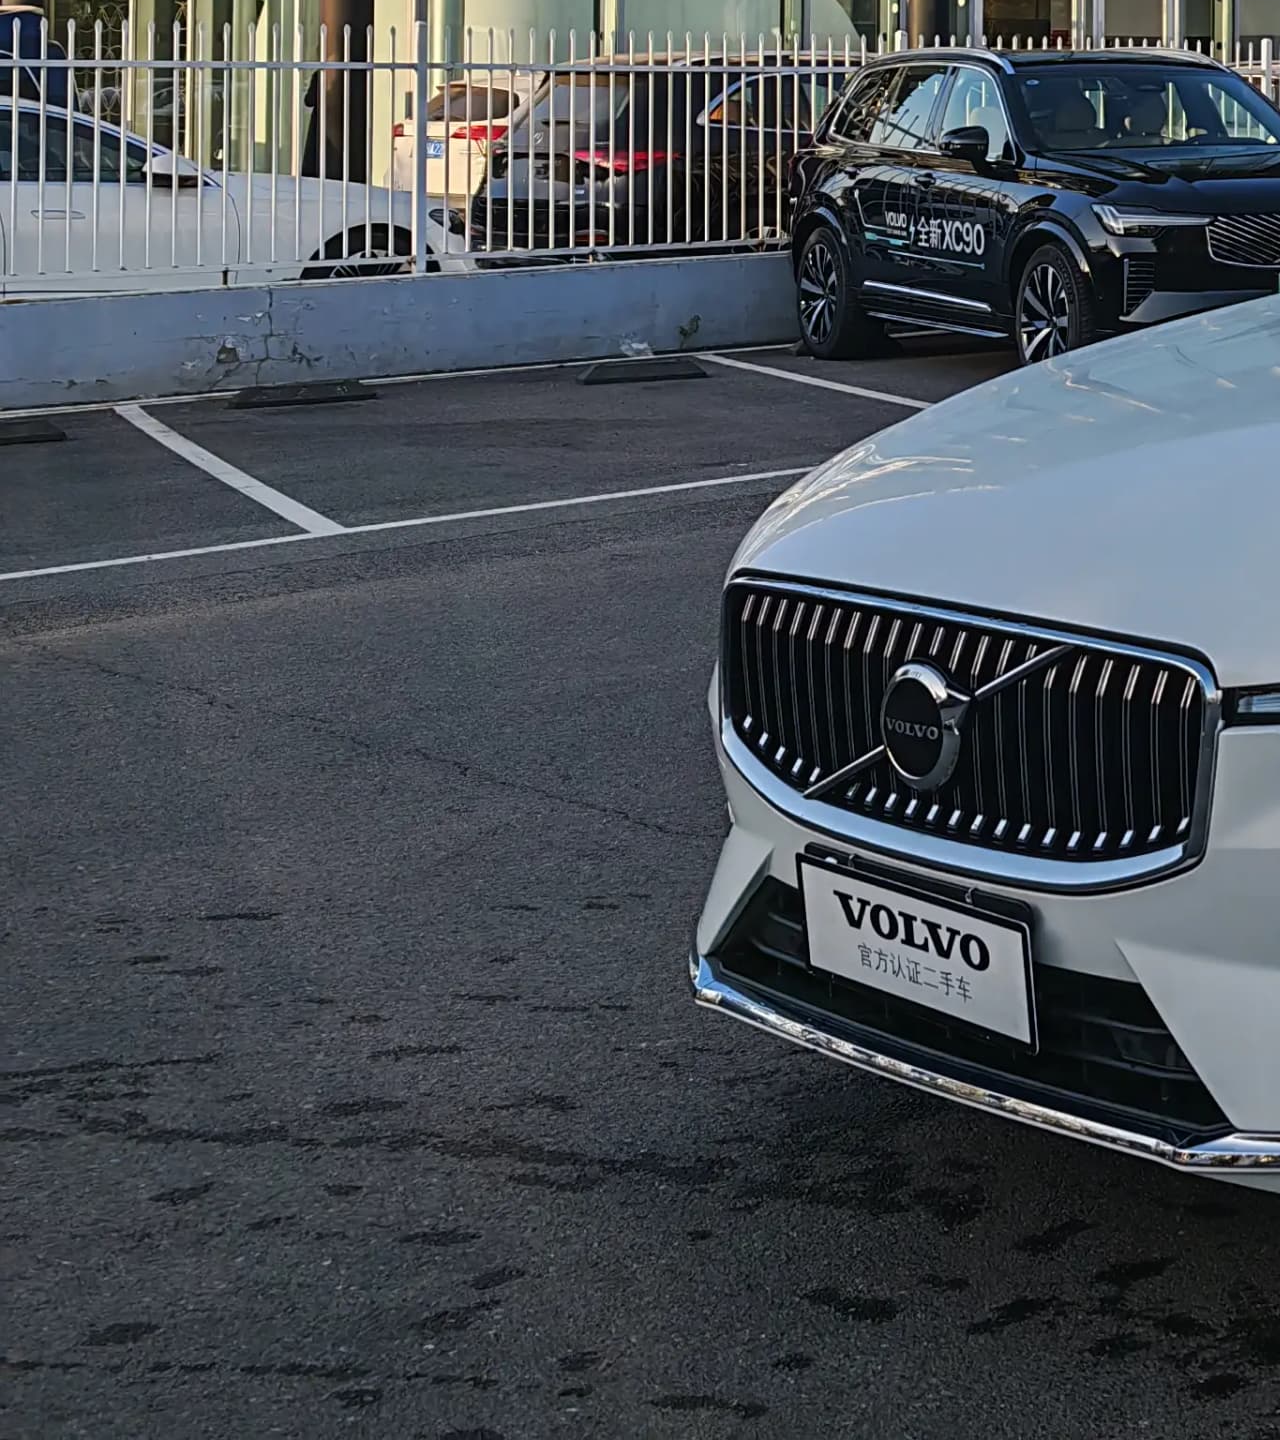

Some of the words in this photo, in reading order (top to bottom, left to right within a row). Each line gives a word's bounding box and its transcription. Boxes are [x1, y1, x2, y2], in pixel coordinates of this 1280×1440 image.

[885, 211, 907, 228] VOLVO
[917, 216, 985, 255] 全新XC90
[886, 717, 939, 740] VOLVO
[833, 890, 990, 972] VOLVO
[857, 942, 973, 1003] 官方认证二手车
